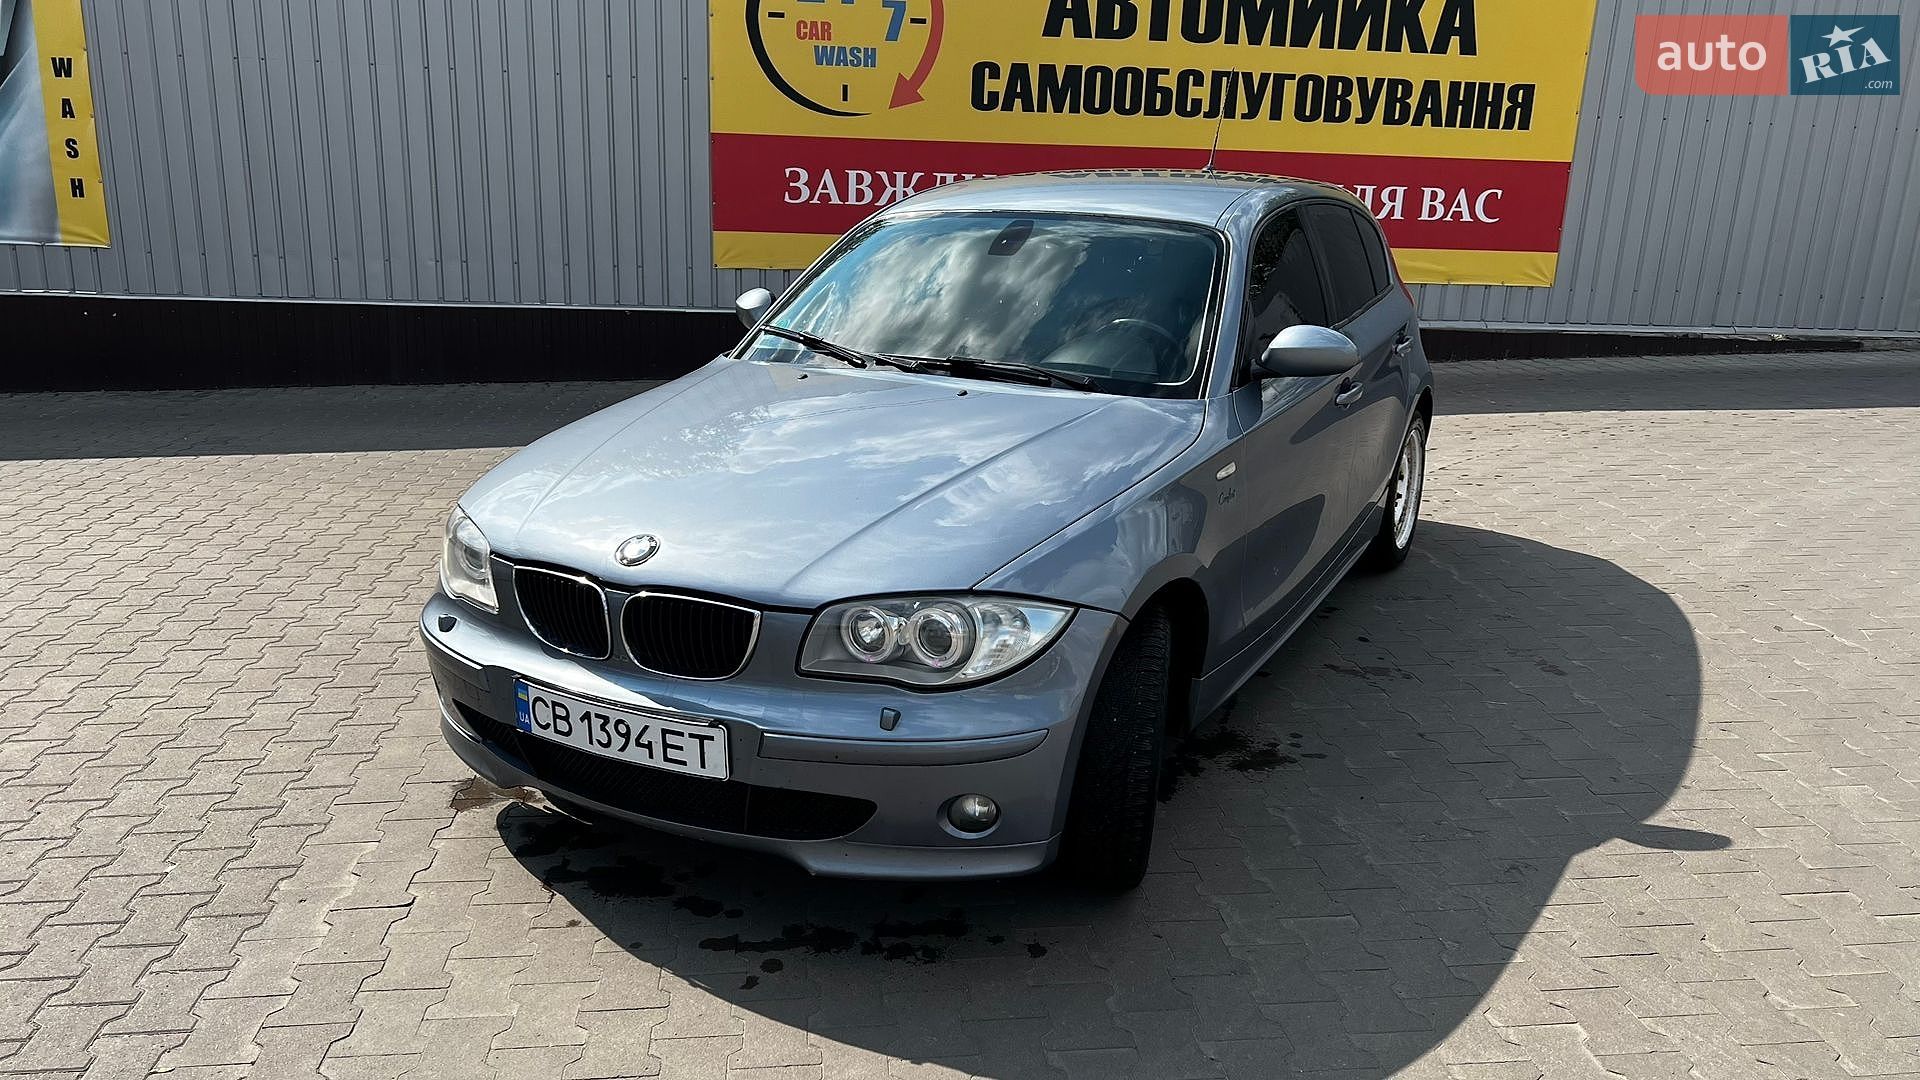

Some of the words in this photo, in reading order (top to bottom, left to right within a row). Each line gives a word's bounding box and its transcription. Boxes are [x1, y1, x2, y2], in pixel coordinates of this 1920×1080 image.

[796, 20, 832, 41] CAR
[814, 45, 877, 68] WASH
[971, 61, 1537, 131] САМООБСЛУГОВУВАННЯ
[51, 56, 85, 199] WASH
[1417, 187, 1503, 224] ВАС
[519, 711, 530, 724] UA
